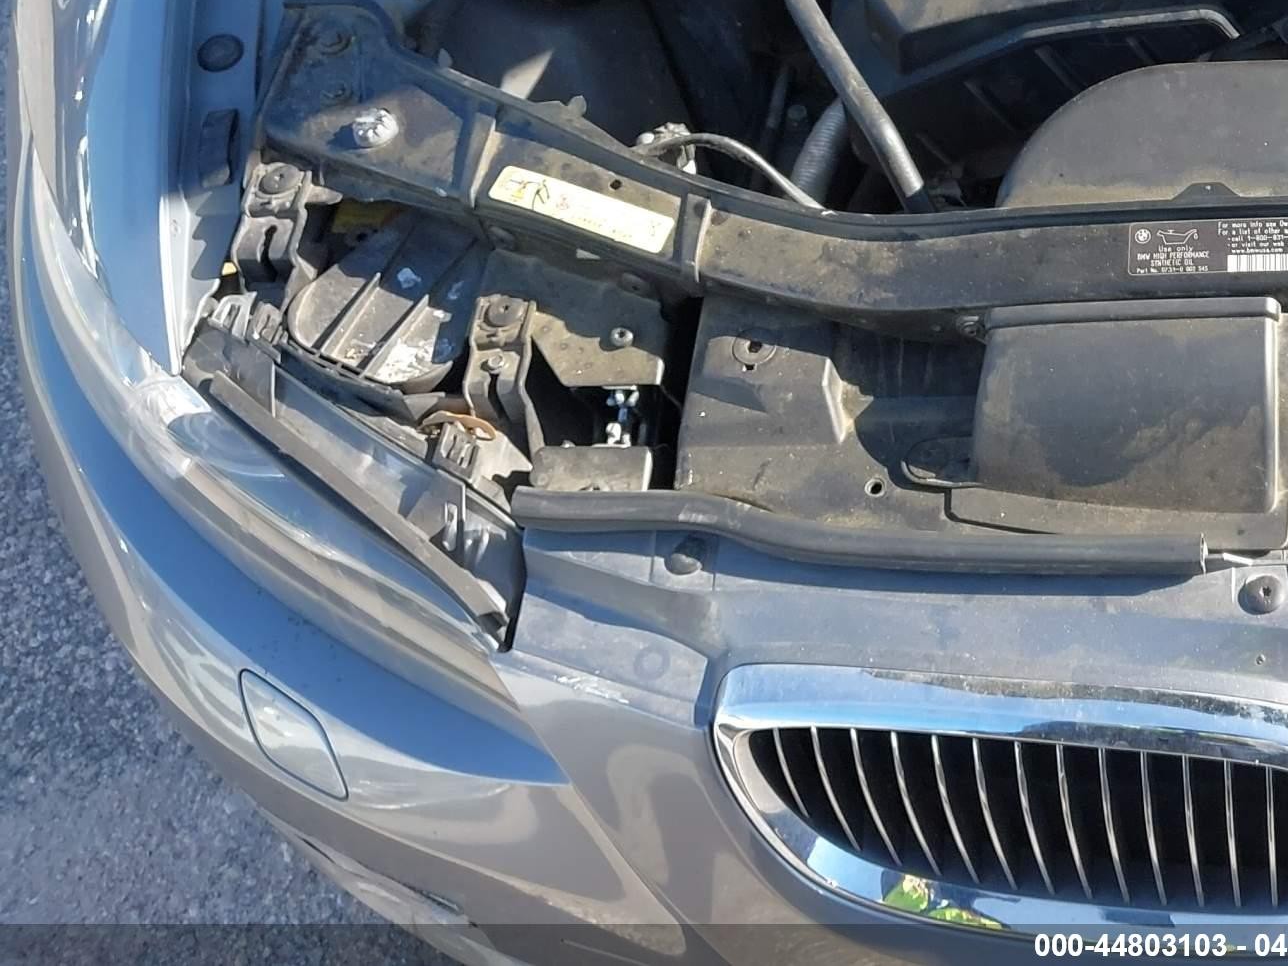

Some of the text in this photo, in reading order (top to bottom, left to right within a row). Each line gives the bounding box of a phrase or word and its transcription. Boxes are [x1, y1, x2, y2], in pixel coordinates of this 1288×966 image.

[1158, 244, 1193, 253] Use only
[1169, 250, 1210, 259] PERFORMANCE
